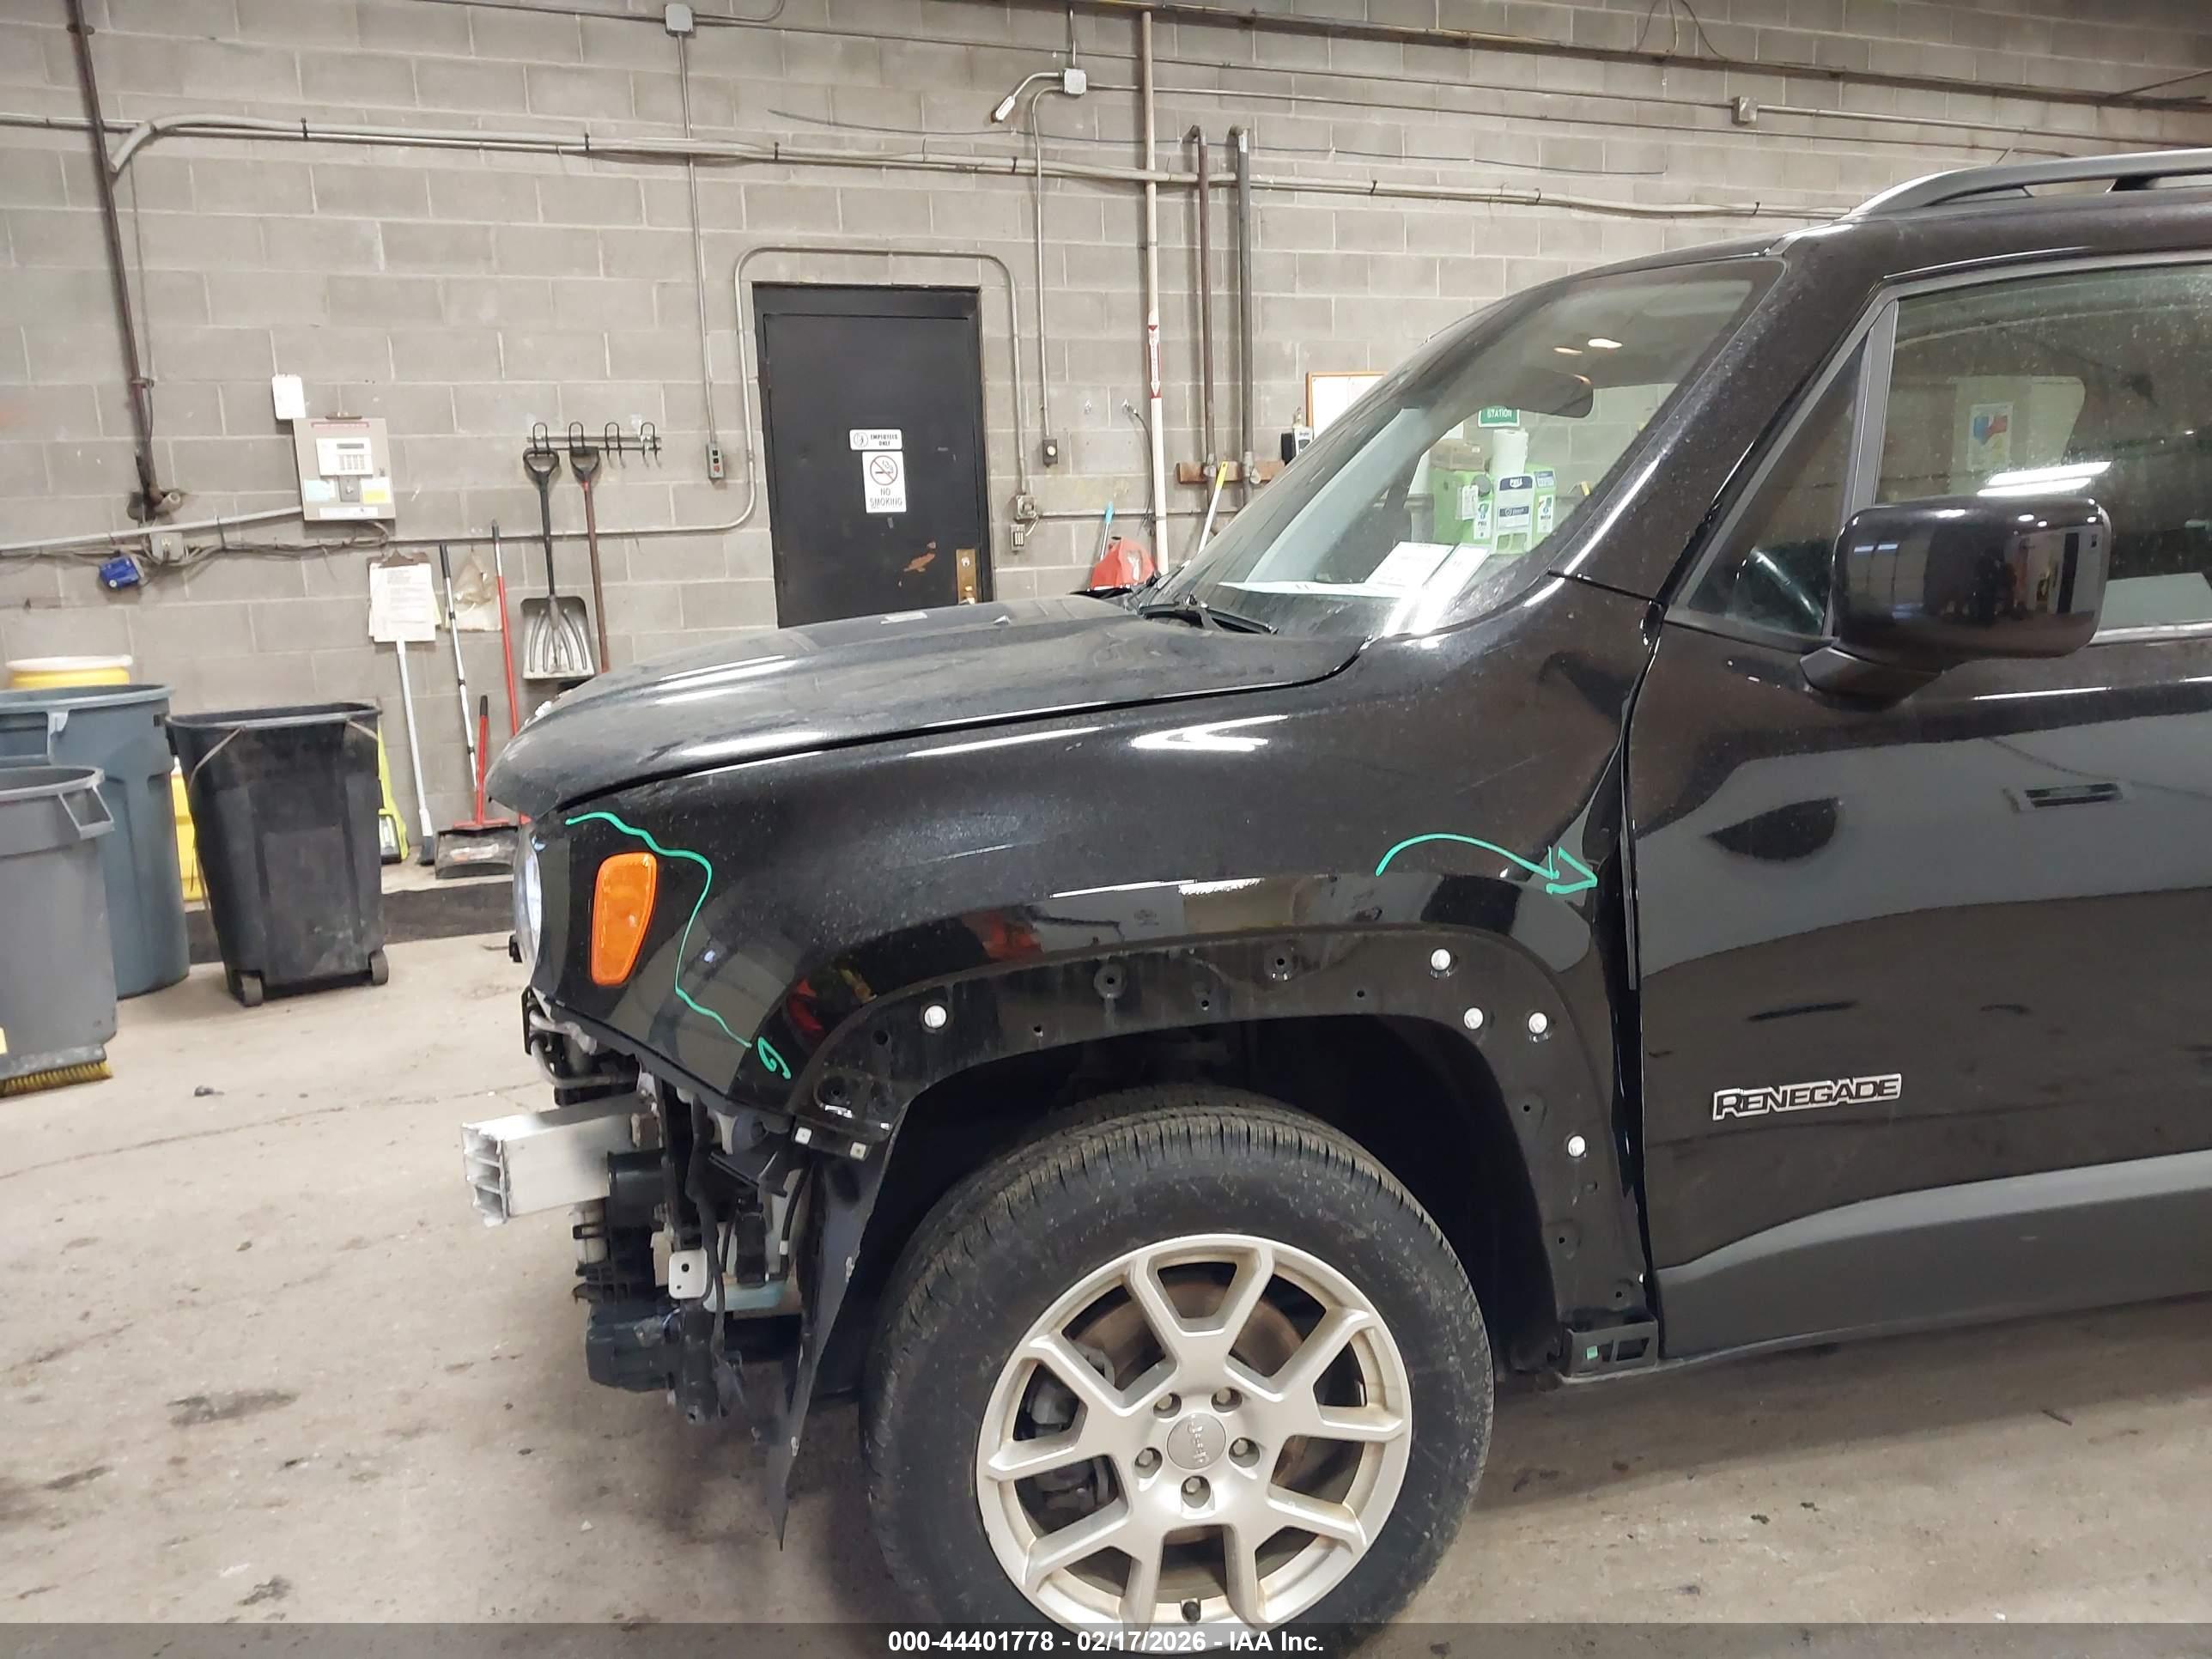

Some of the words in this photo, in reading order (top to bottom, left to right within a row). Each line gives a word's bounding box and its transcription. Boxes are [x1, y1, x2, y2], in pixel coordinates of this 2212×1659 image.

[1486, 408, 1512, 418] STATION
[880, 487, 891, 496] NO
[869, 497, 902, 507] SMOKING
[1713, 1073, 1901, 1121] RENEGADE
